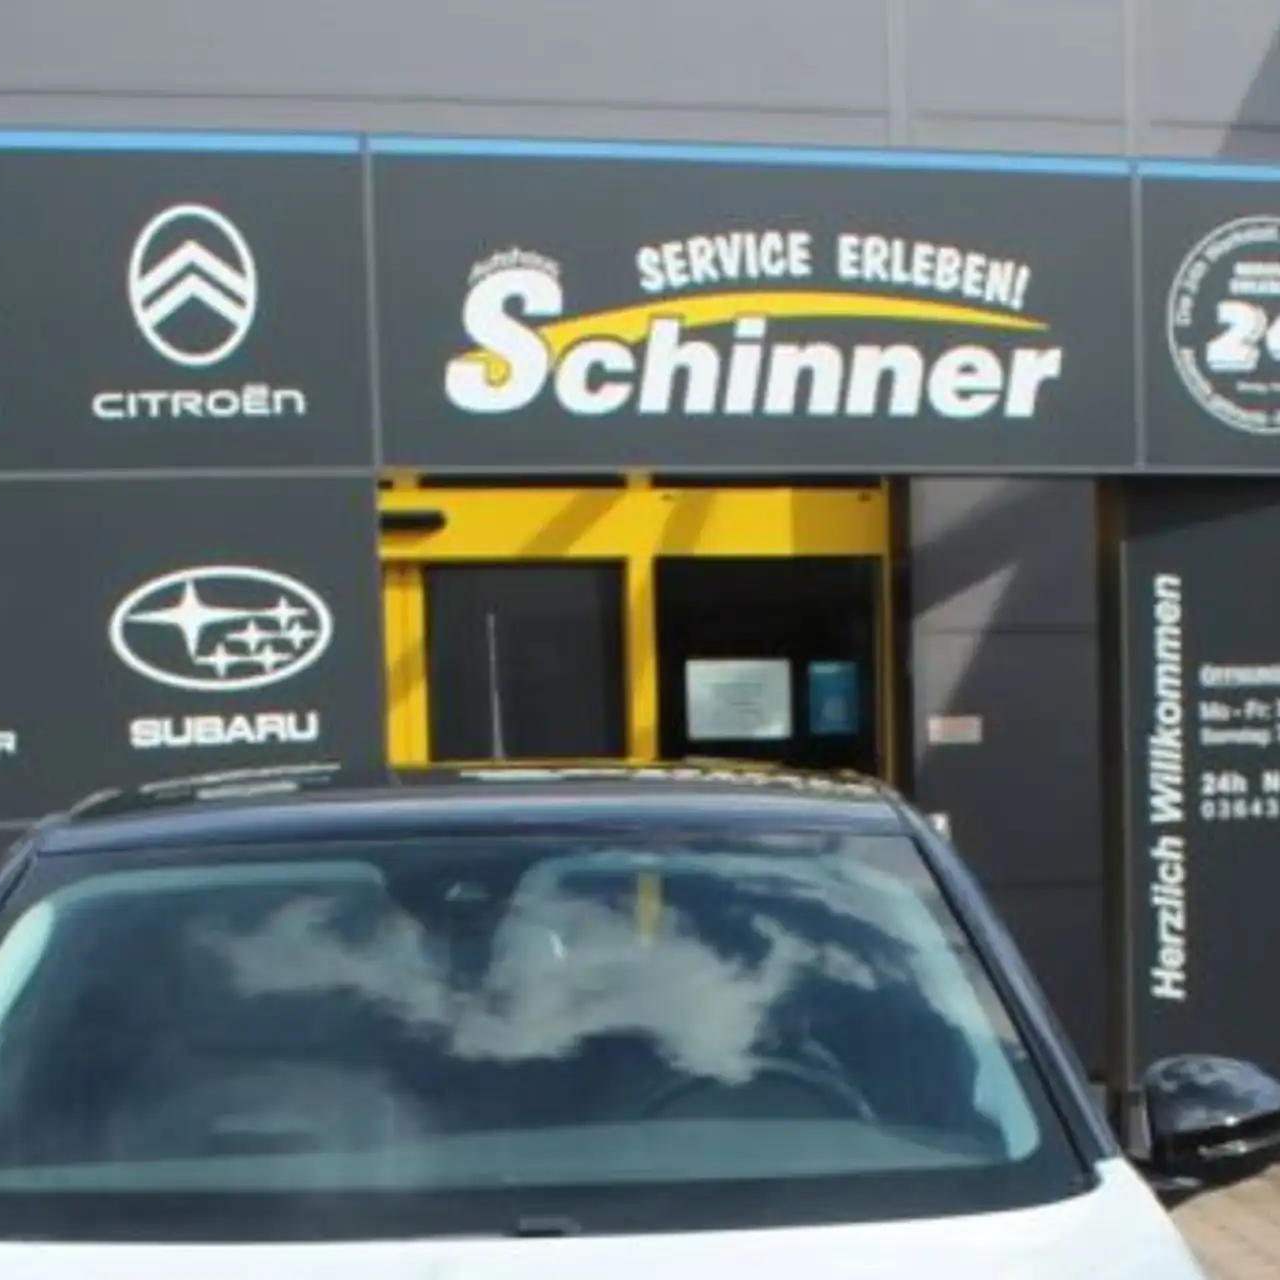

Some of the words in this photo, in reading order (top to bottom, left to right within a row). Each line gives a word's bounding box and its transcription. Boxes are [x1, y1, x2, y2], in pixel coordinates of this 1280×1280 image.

[636, 230, 813, 291] SERVICE
[837, 233, 1031, 310] ERLEBEN!
[444, 268, 1063, 418] Schinner
[91, 384, 307, 420] CITROËN
[129, 711, 319, 748] SUBARU
[1149, 572, 1183, 825] Willkommen
[1200, 770, 1249, 796] 24h
[1149, 835, 1188, 1001] Herzlich
